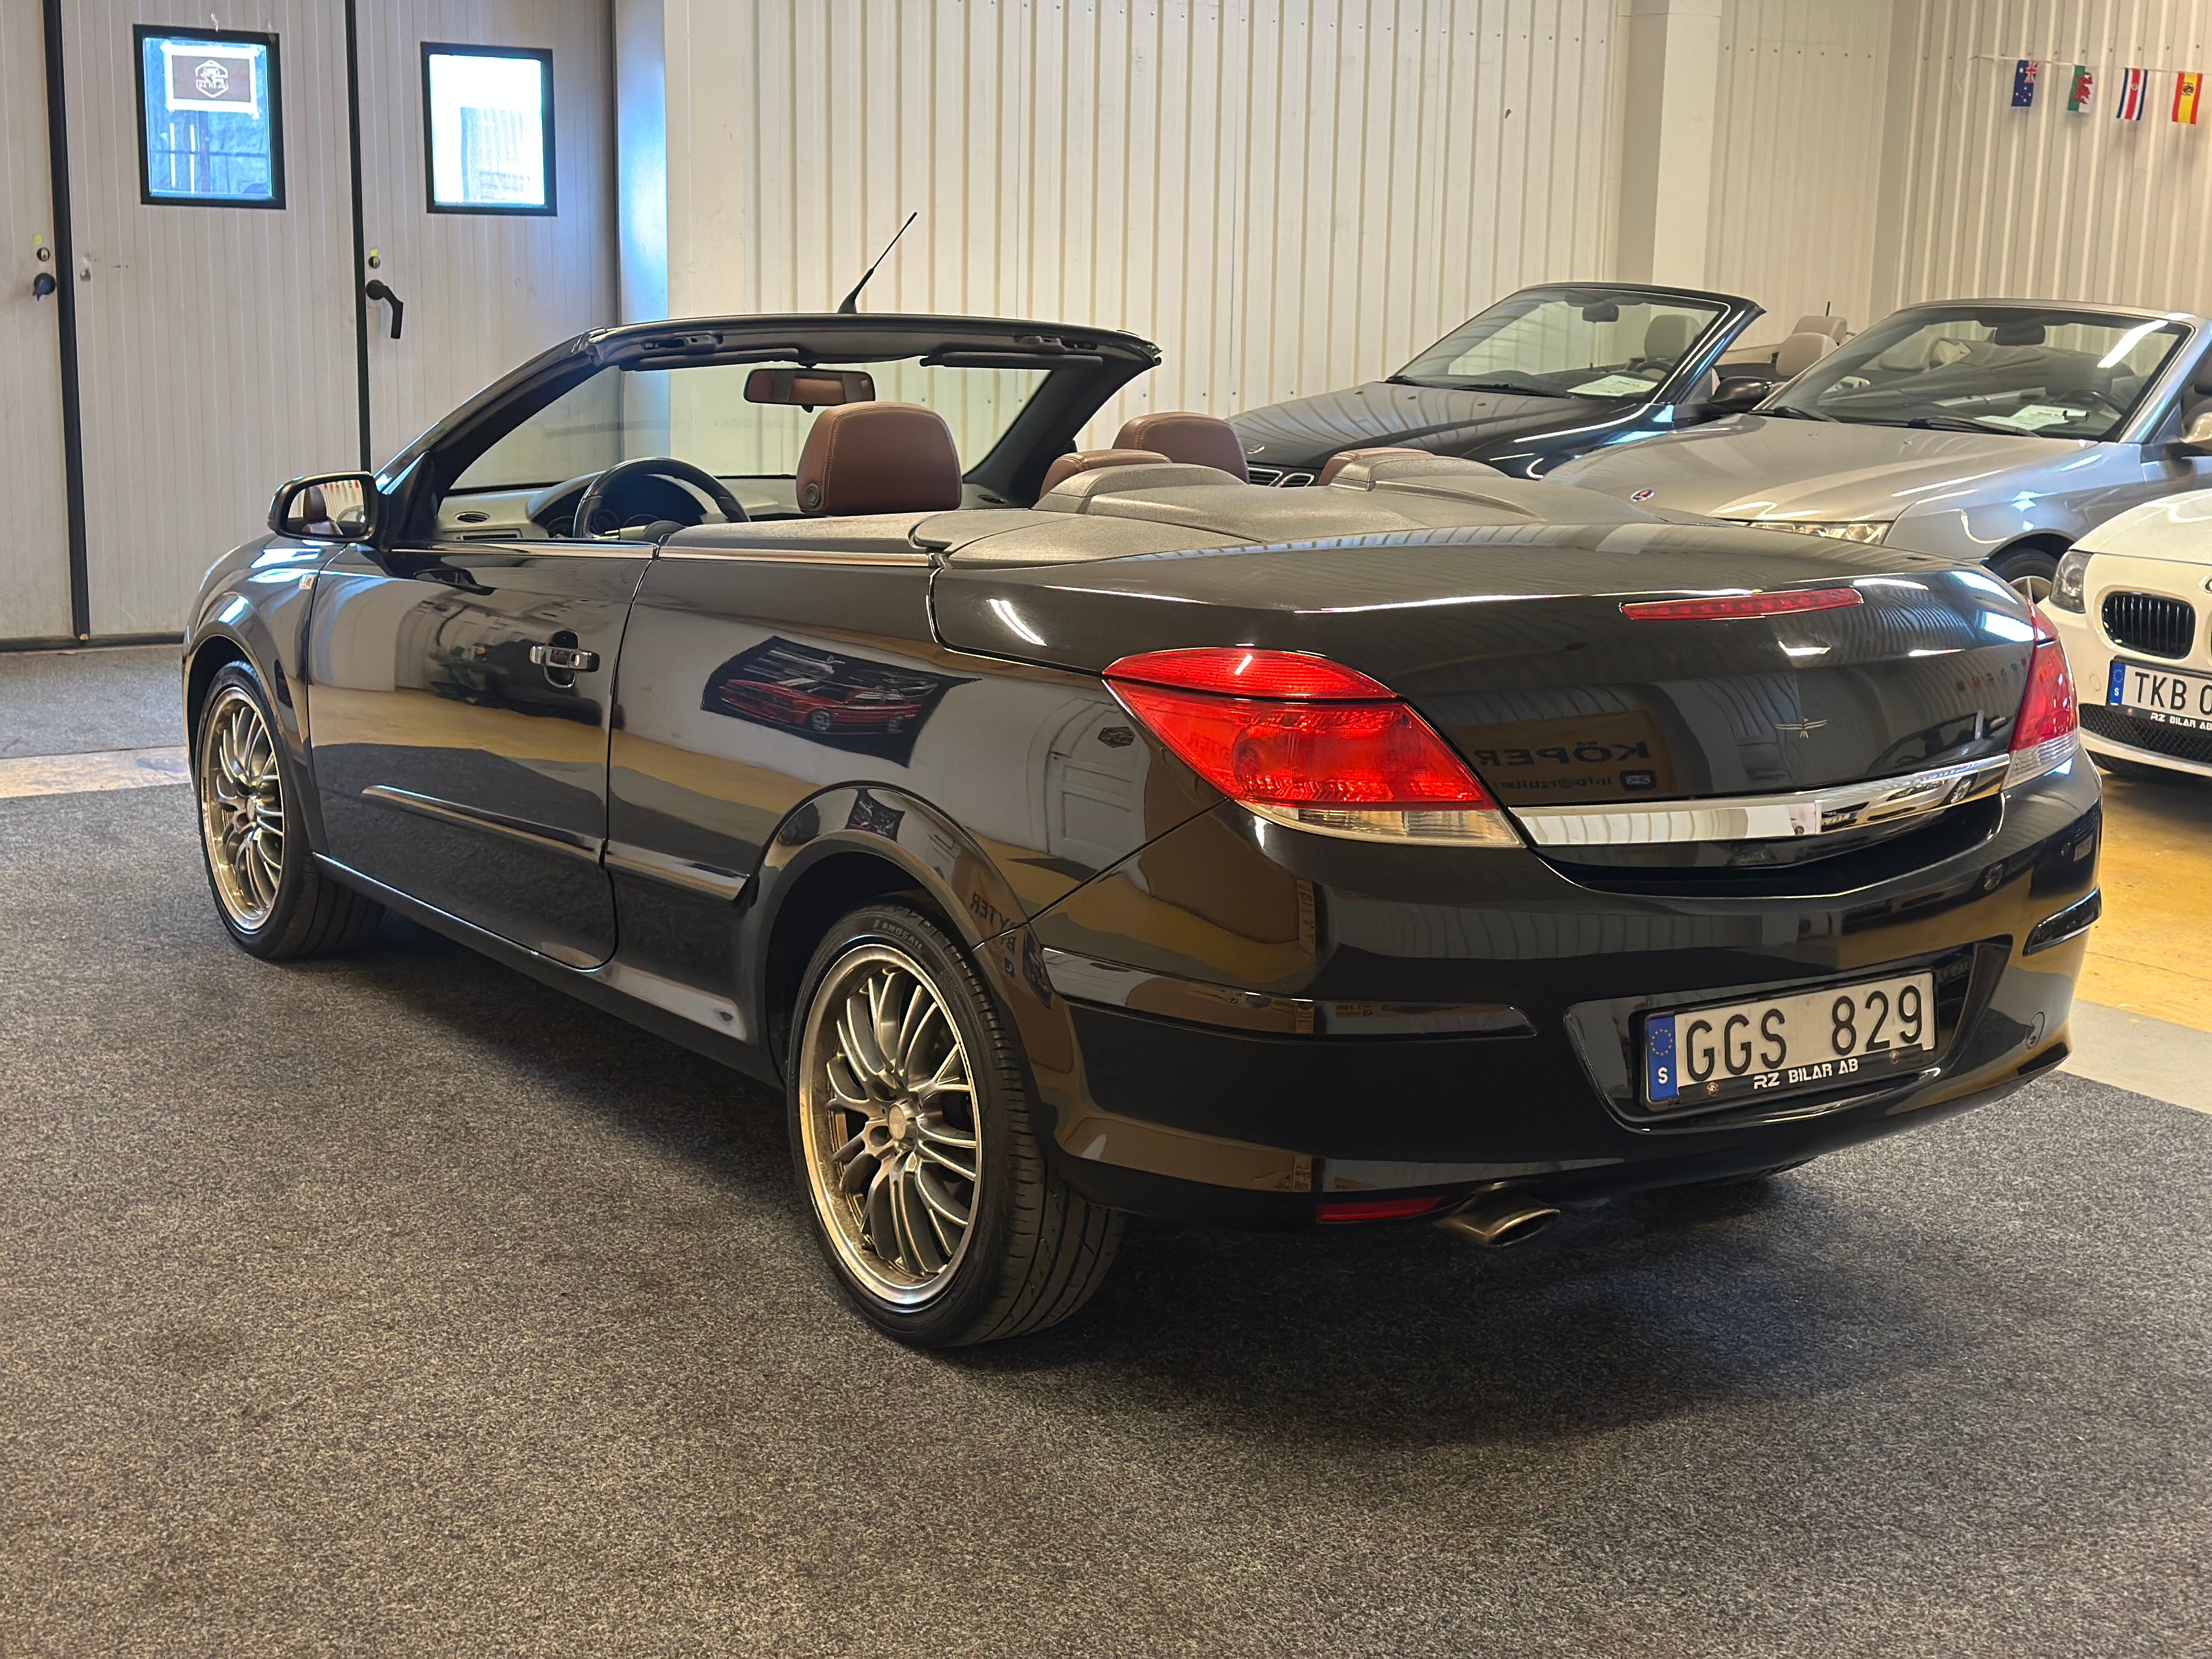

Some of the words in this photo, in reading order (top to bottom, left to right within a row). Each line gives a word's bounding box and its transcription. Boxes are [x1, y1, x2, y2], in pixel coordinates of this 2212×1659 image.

[2114, 687, 2119, 697] S
[2135, 671, 2187, 710] TKB
[2150, 712, 2166, 722] RZ
[2169, 715, 2196, 728] BILAR
[2199, 721, 2212, 731] AB
[1685, 1008, 1787, 1082] GGS
[1831, 985, 1921, 1056] 829
[1658, 1067, 1668, 1085] S
[1753, 1072, 1780, 1090] RZ
[1788, 1063, 1832, 1084] BILAR
[1838, 1058, 1859, 1074] AB
